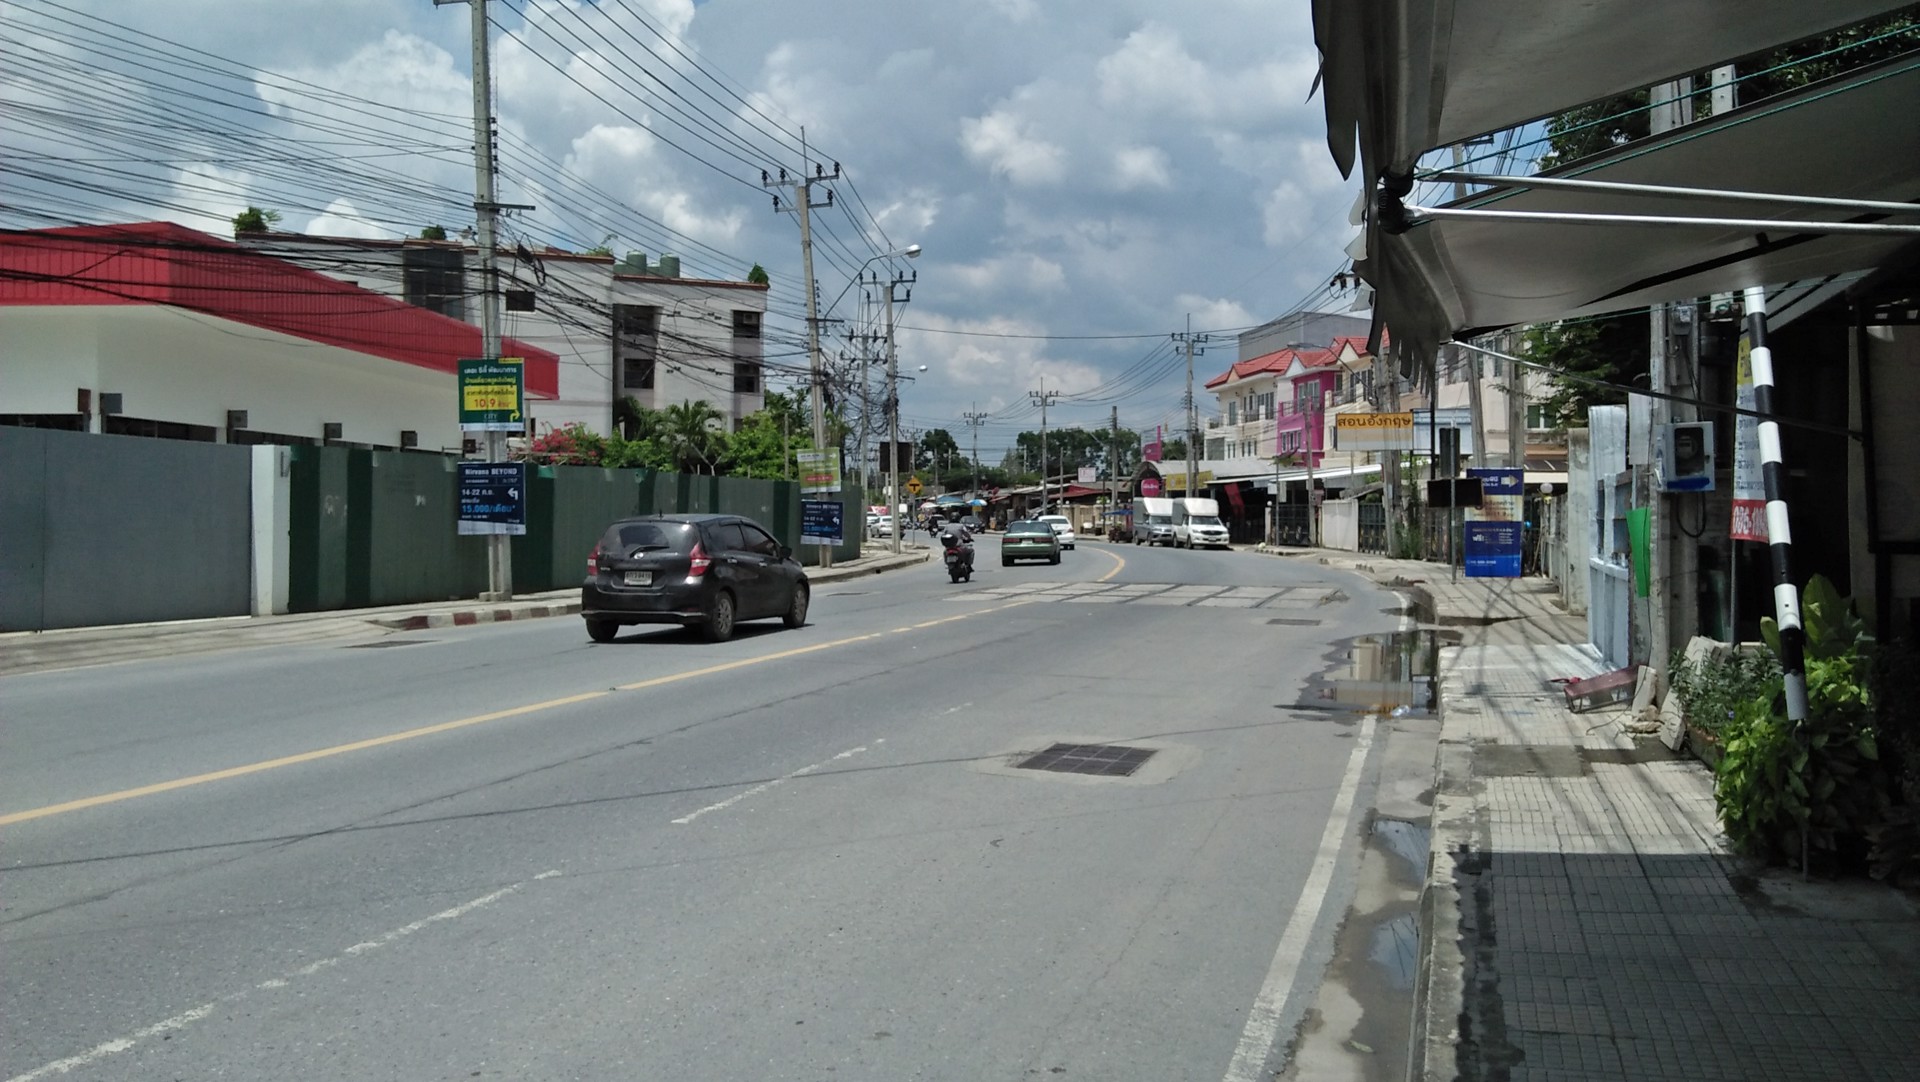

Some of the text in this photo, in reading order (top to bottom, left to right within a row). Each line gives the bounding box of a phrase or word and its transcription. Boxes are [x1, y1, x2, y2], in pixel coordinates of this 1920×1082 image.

[1338, 414, 1411, 428] สอนอังกฤษ
[491, 467, 518, 475] BEYOND
